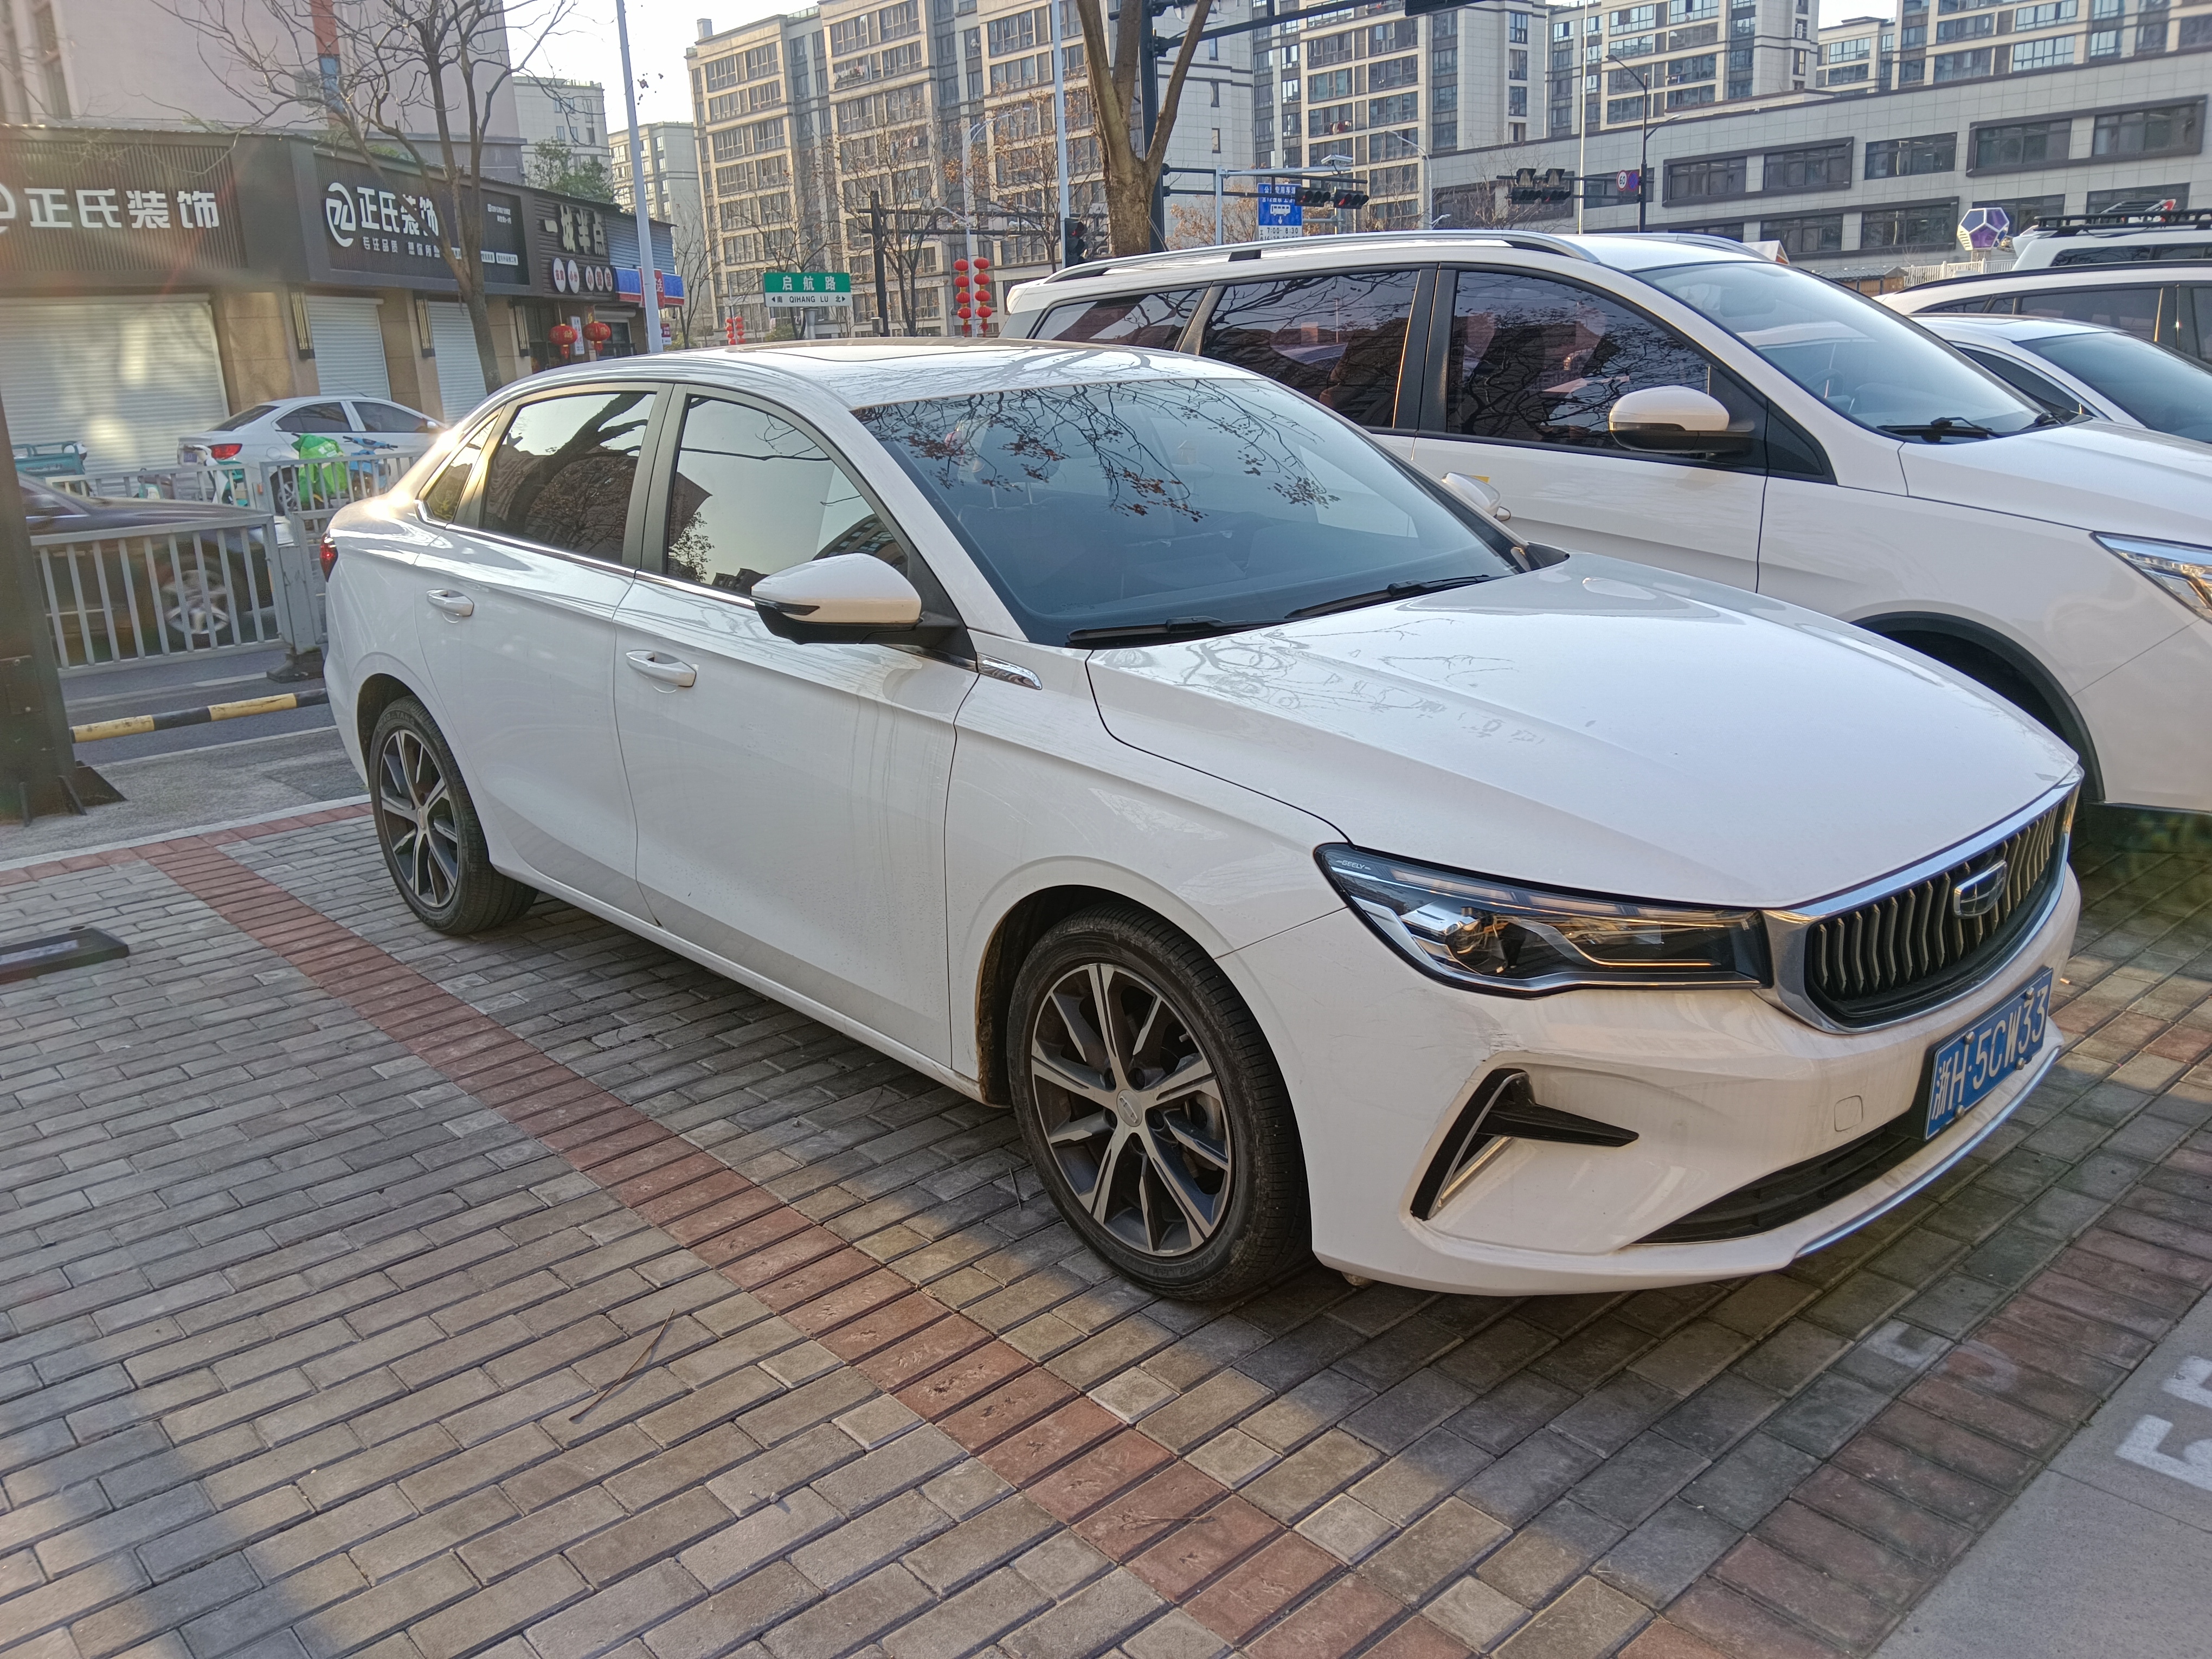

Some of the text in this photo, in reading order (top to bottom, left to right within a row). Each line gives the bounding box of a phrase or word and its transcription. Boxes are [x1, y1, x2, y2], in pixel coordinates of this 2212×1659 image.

[1620, 176, 1625, 184] 60
[1264, 186, 1296, 194] 公专用车道
[24, 188, 220, 229] 正氏装饰
[357, 187, 439, 236] 正氏装饰
[782, 275, 835, 291] 启航路
